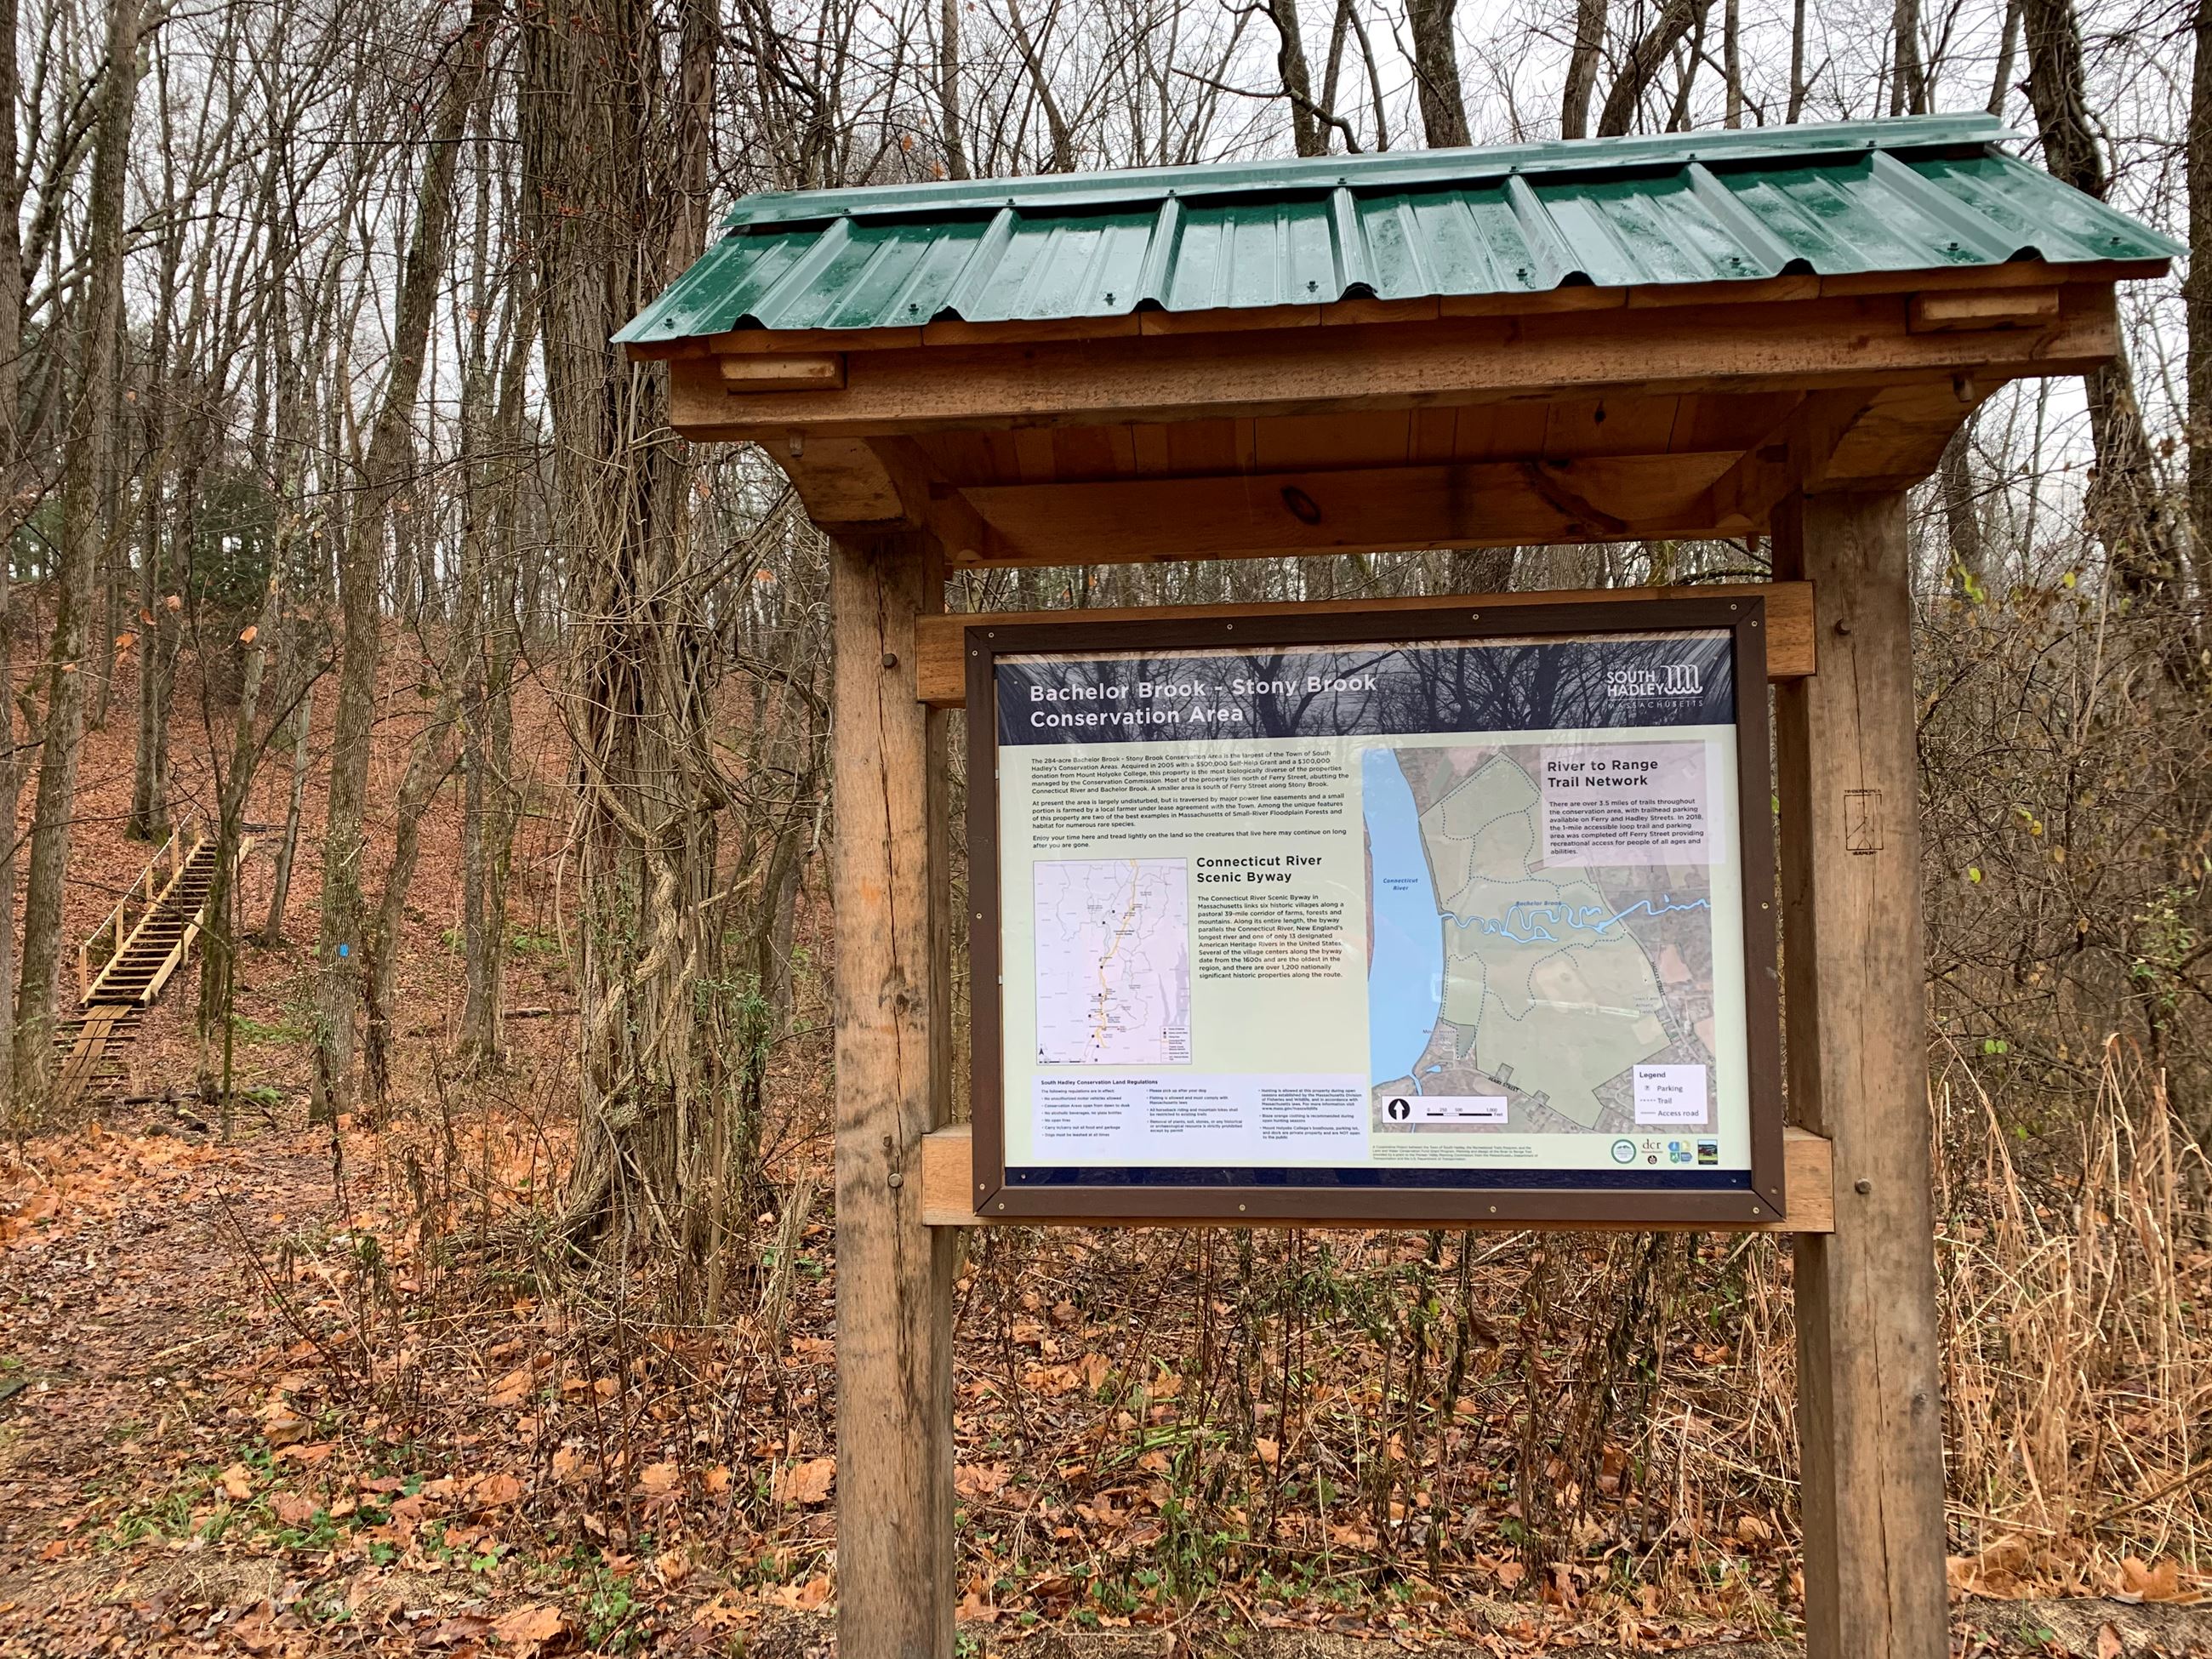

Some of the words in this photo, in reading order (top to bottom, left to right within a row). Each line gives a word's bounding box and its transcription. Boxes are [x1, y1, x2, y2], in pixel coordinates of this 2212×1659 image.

[1607, 670, 1655, 683] SOUTH
[1030, 682, 1129, 701] Bachelor
[1138, 680, 1206, 698] Brook
[1232, 678, 1297, 697] Stony
[1307, 674, 1377, 693] Brook
[1607, 683, 1665, 696] HADLEY
[1608, 701, 1703, 709] MASSACHUSETTS
[1030, 708, 1179, 728] Conservation
[1189, 706, 1243, 723] Area
[1547, 760, 1585, 771] River
[1590, 761, 1606, 770] to
[1612, 759, 1658, 771] Range
[1547, 776, 1579, 787] Trail
[1585, 775, 1648, 786] Network
[1196, 856, 1280, 867] Connecticut
[1286, 855, 1322, 865] River
[1197, 872, 1241, 882] Scenic
[1247, 871, 1291, 883] Byway
[1642, 1139, 1661, 1149] dcr
